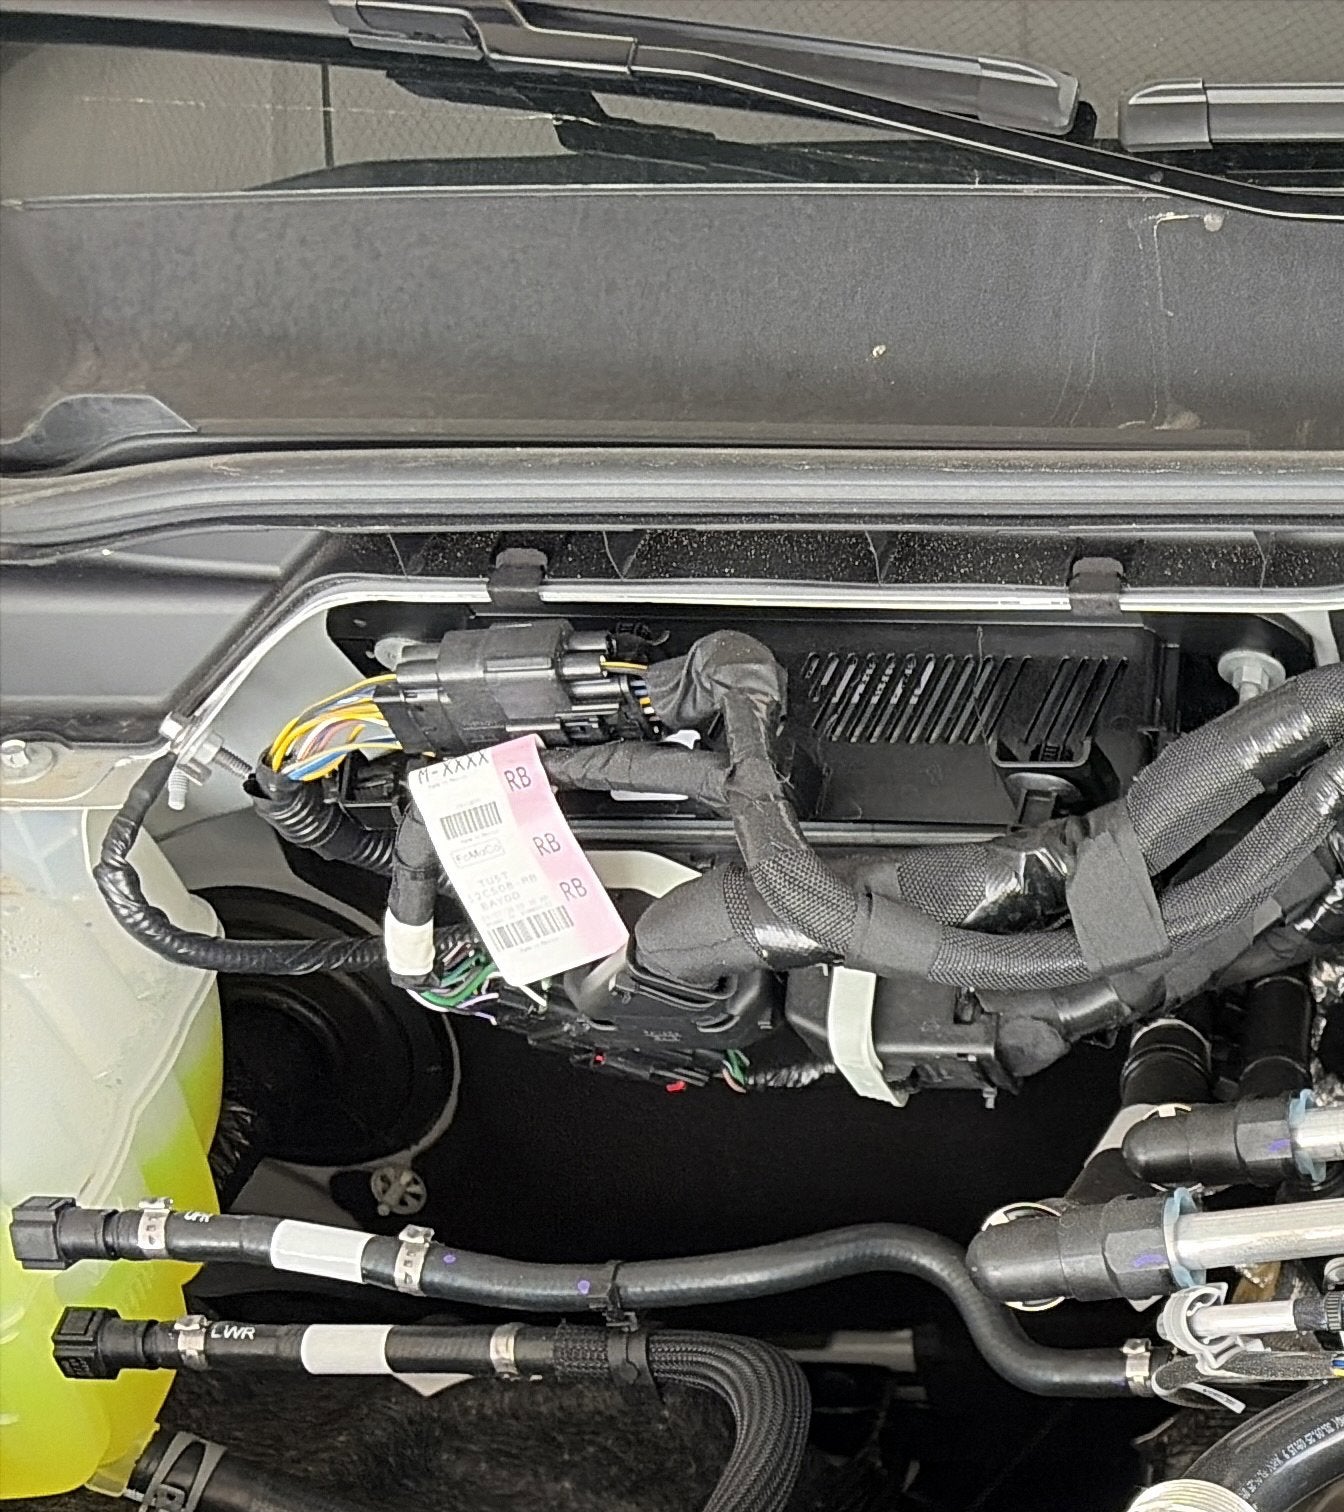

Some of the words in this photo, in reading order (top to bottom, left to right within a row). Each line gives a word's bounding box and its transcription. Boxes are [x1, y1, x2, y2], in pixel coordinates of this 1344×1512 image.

[503, 765, 532, 793] RB
[532, 832, 562, 857] RB
[559, 877, 588, 902] RB
[210, 1323, 256, 1340] LWR
